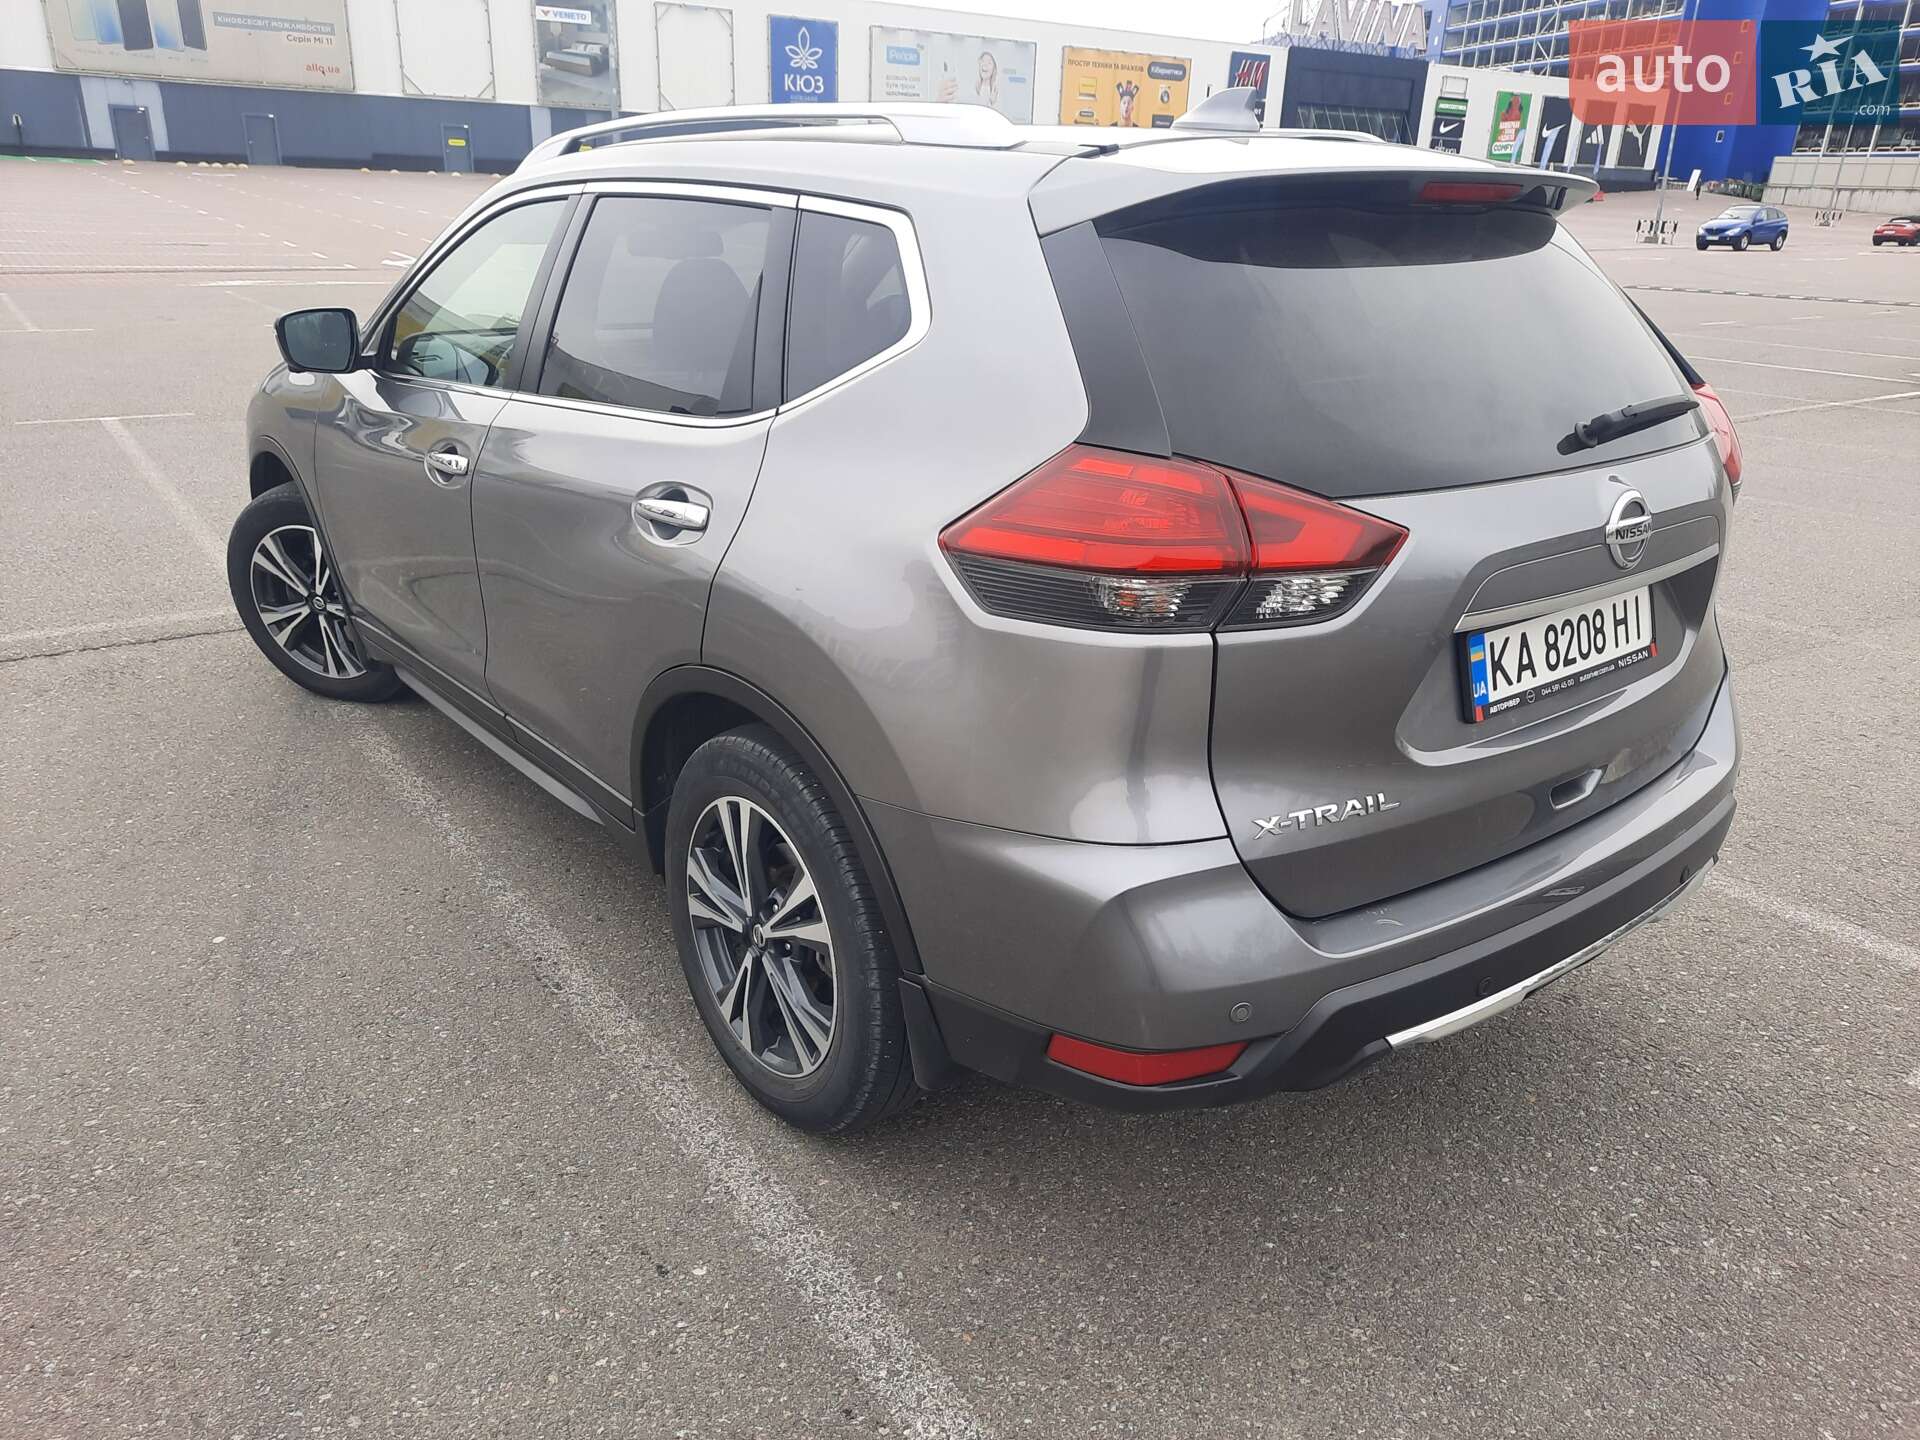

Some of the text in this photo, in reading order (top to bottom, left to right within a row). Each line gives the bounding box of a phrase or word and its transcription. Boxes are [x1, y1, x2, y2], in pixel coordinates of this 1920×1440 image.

[552, 9, 587, 20] VENETO
[784, 73, 824, 94] КЮЗ
[1544, 608, 1607, 672] 8208
[1618, 650, 1649, 669] NISSAN
[1472, 682, 1487, 698] UA
[1252, 792, 1401, 840] X-TRAIL
